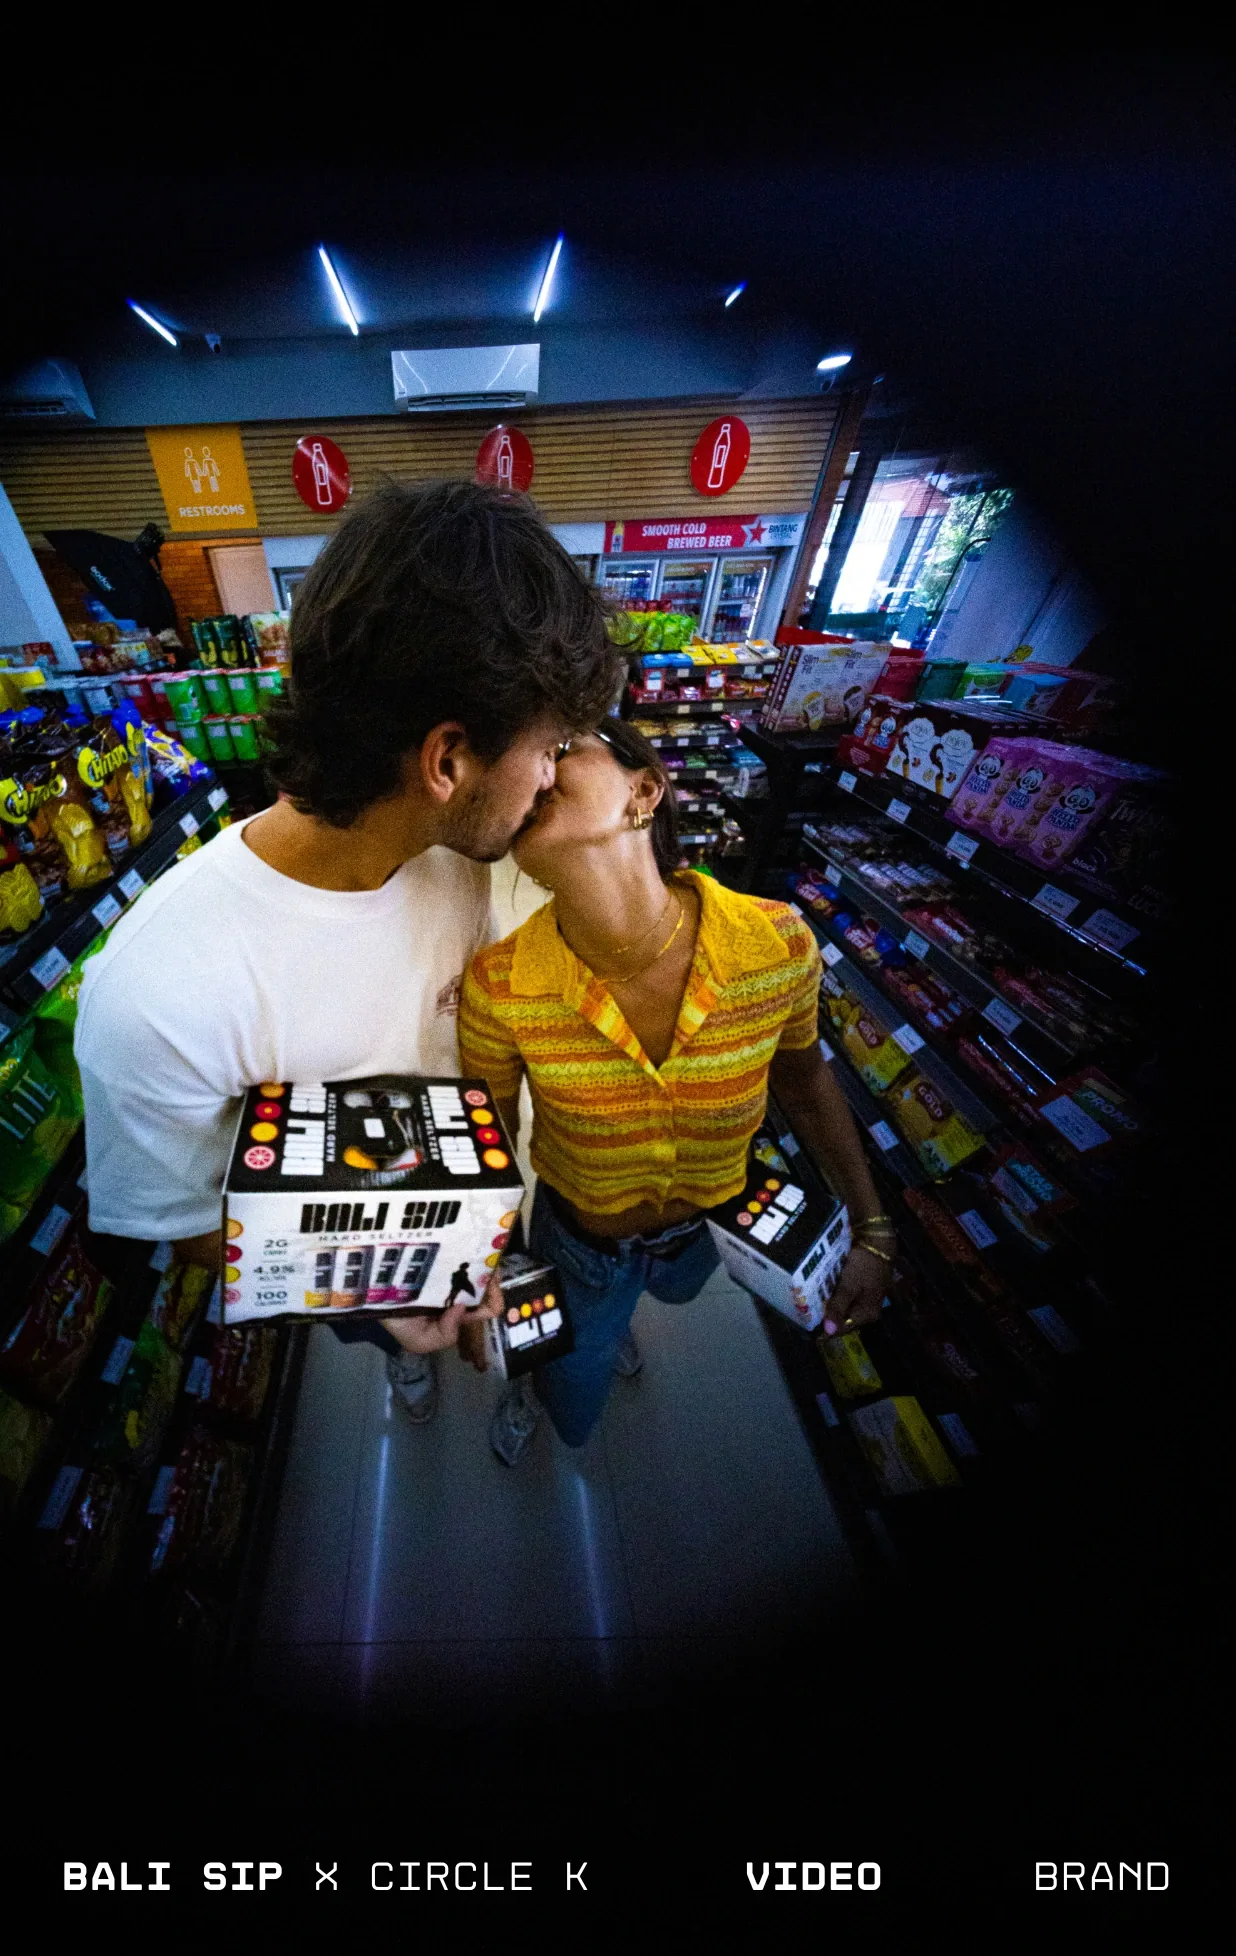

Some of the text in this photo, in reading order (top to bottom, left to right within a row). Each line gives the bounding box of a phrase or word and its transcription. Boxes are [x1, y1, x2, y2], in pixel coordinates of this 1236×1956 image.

[178, 504, 245, 517] RESTROOMS
[642, 523, 707, 536] SMOOTH COLD
[768, 523, 797, 533] BINTANG
[667, 535, 732, 549] BREWED BEER
[918, 1085, 945, 1118] GOLD
[1081, 1090, 1139, 1130] PROMO
[300, 1201, 462, 1233] BALI SIP
[319, 1231, 433, 1242] HARD SELTZER
[264, 1239, 288, 1248] 2G
[256, 1291, 288, 1299] 100
